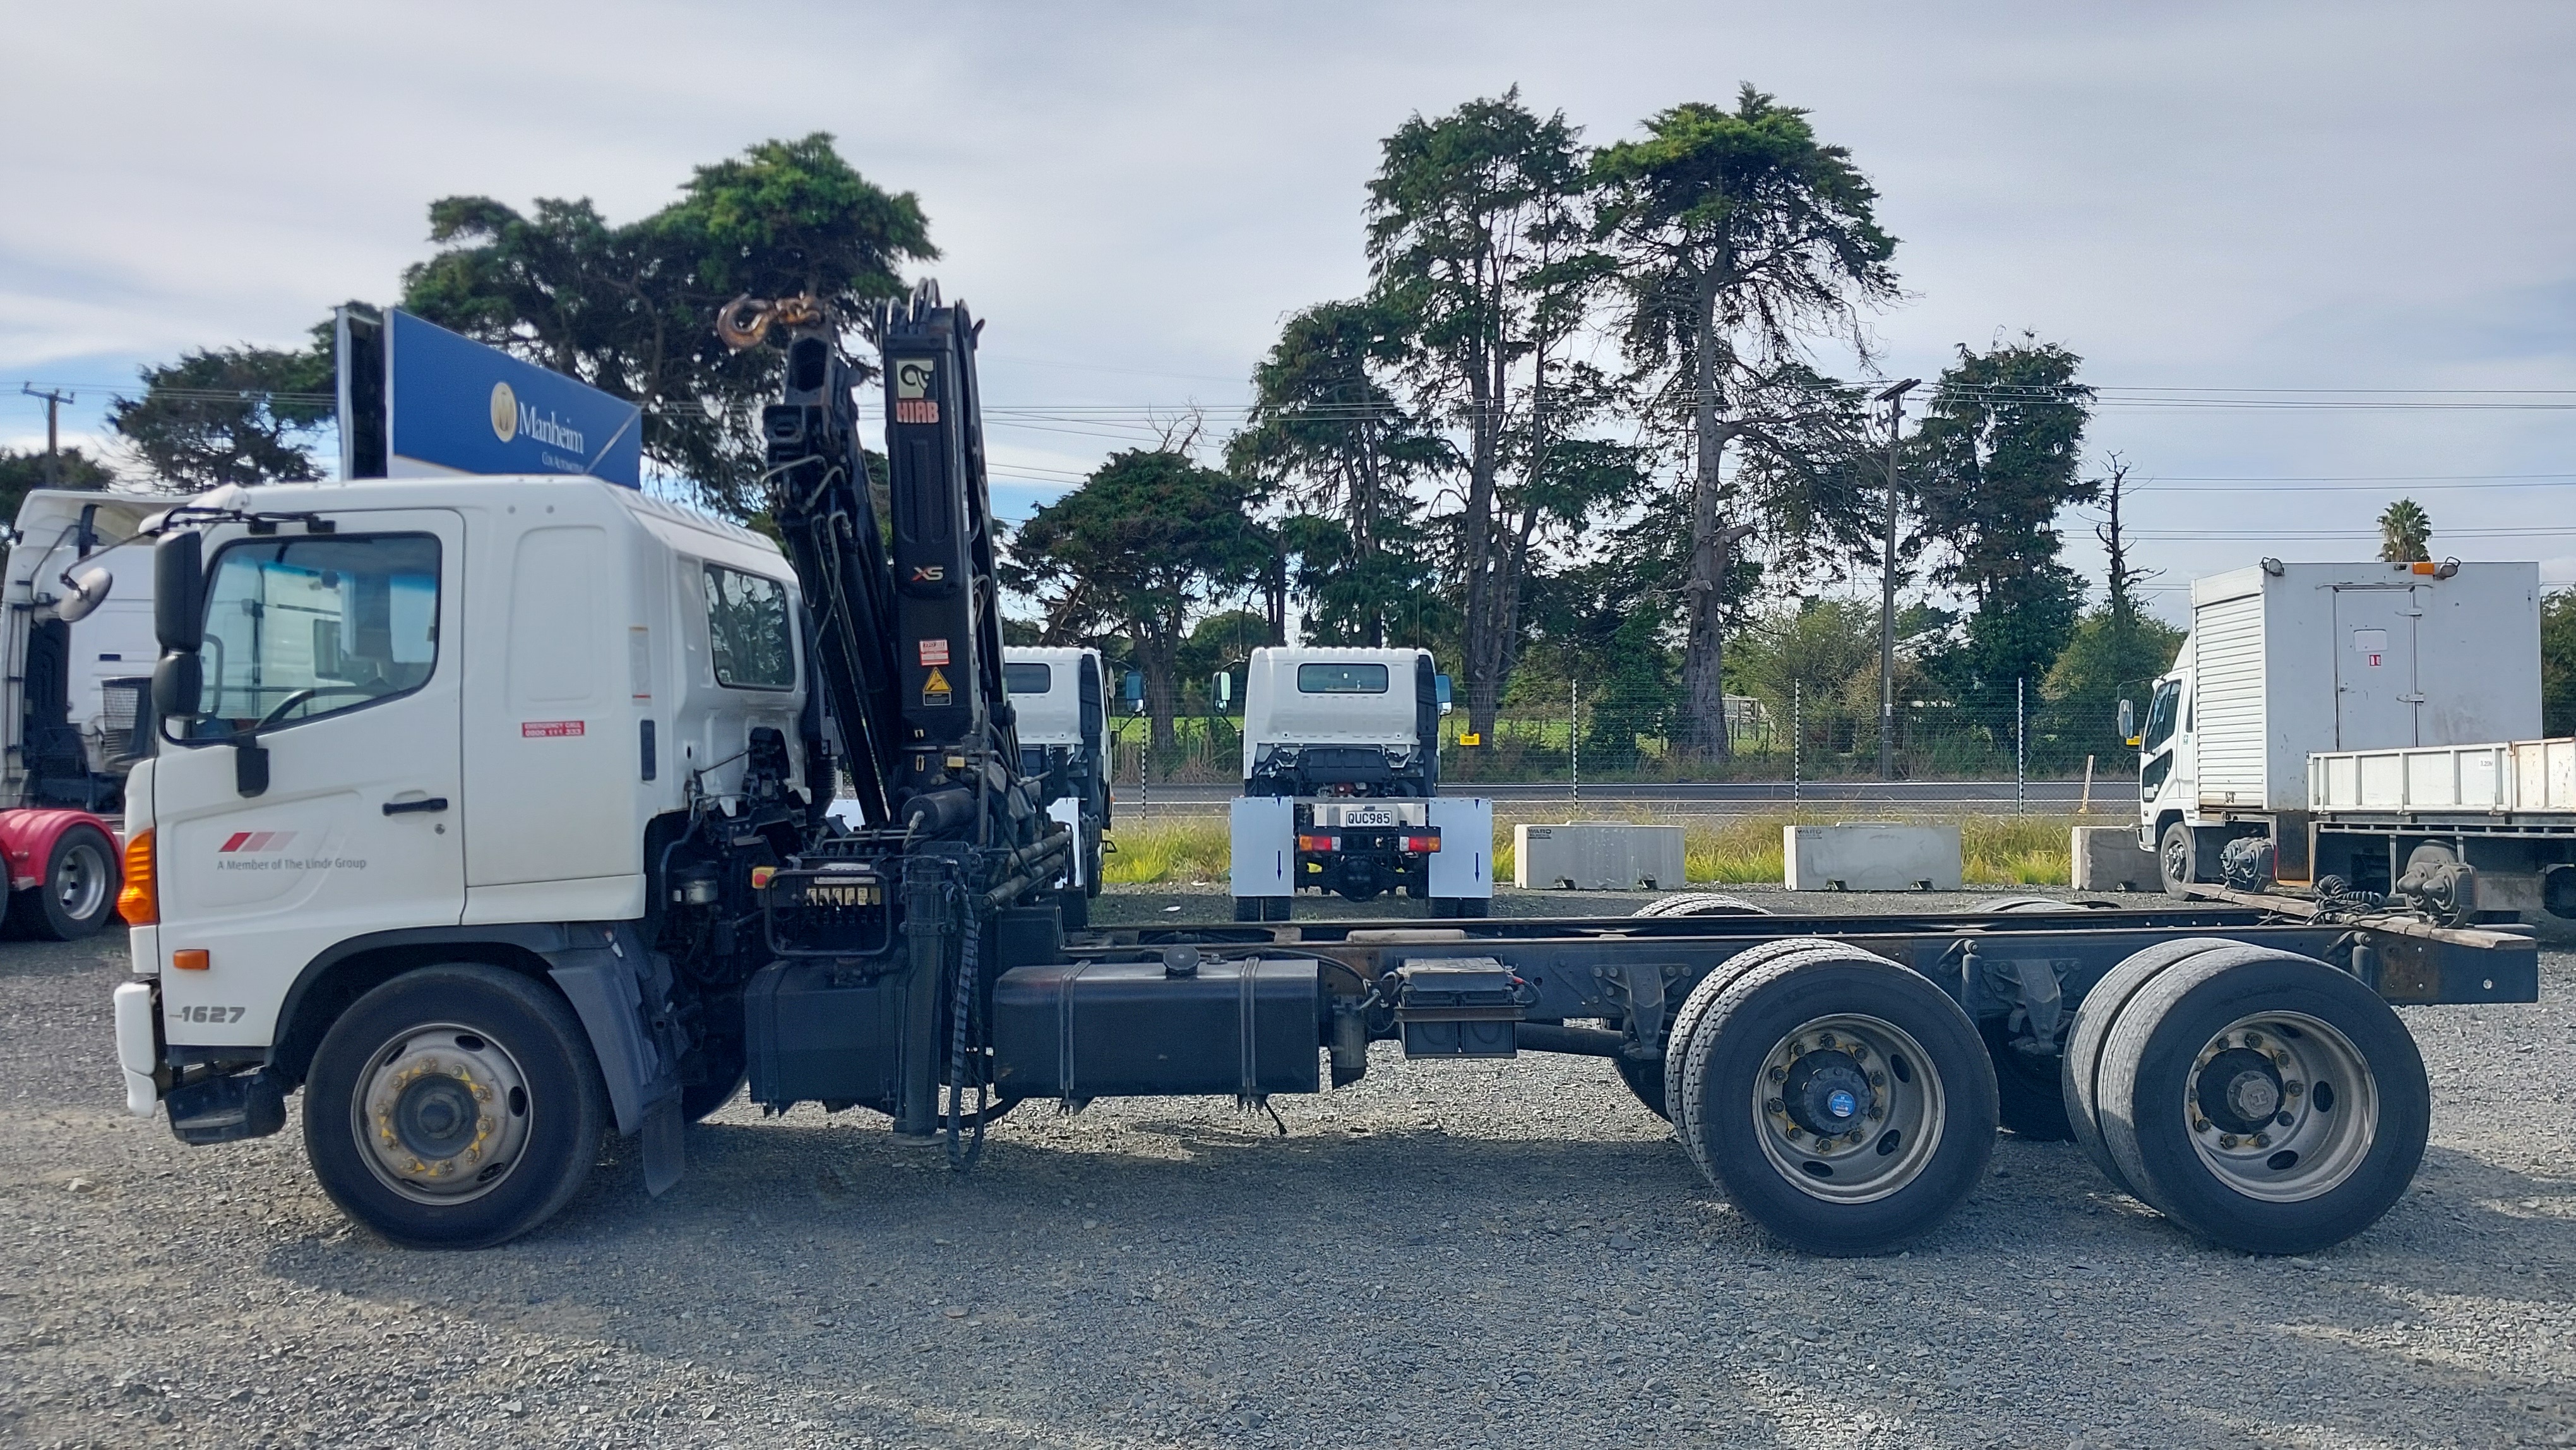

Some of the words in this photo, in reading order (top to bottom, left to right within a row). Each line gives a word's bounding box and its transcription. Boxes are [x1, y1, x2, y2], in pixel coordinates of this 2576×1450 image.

[897, 402, 939, 422] HIAB
[519, 402, 583, 455] Manheim
[912, 567, 943, 581] XS
[1348, 813, 1390, 824] QUC985
[217, 860, 224, 870] A
[227, 859, 268, 870] Member
[271, 858, 282, 870] of
[285, 858, 303, 870] The
[335, 858, 366, 870] Group
[182, 1006, 245, 1023] 1627
